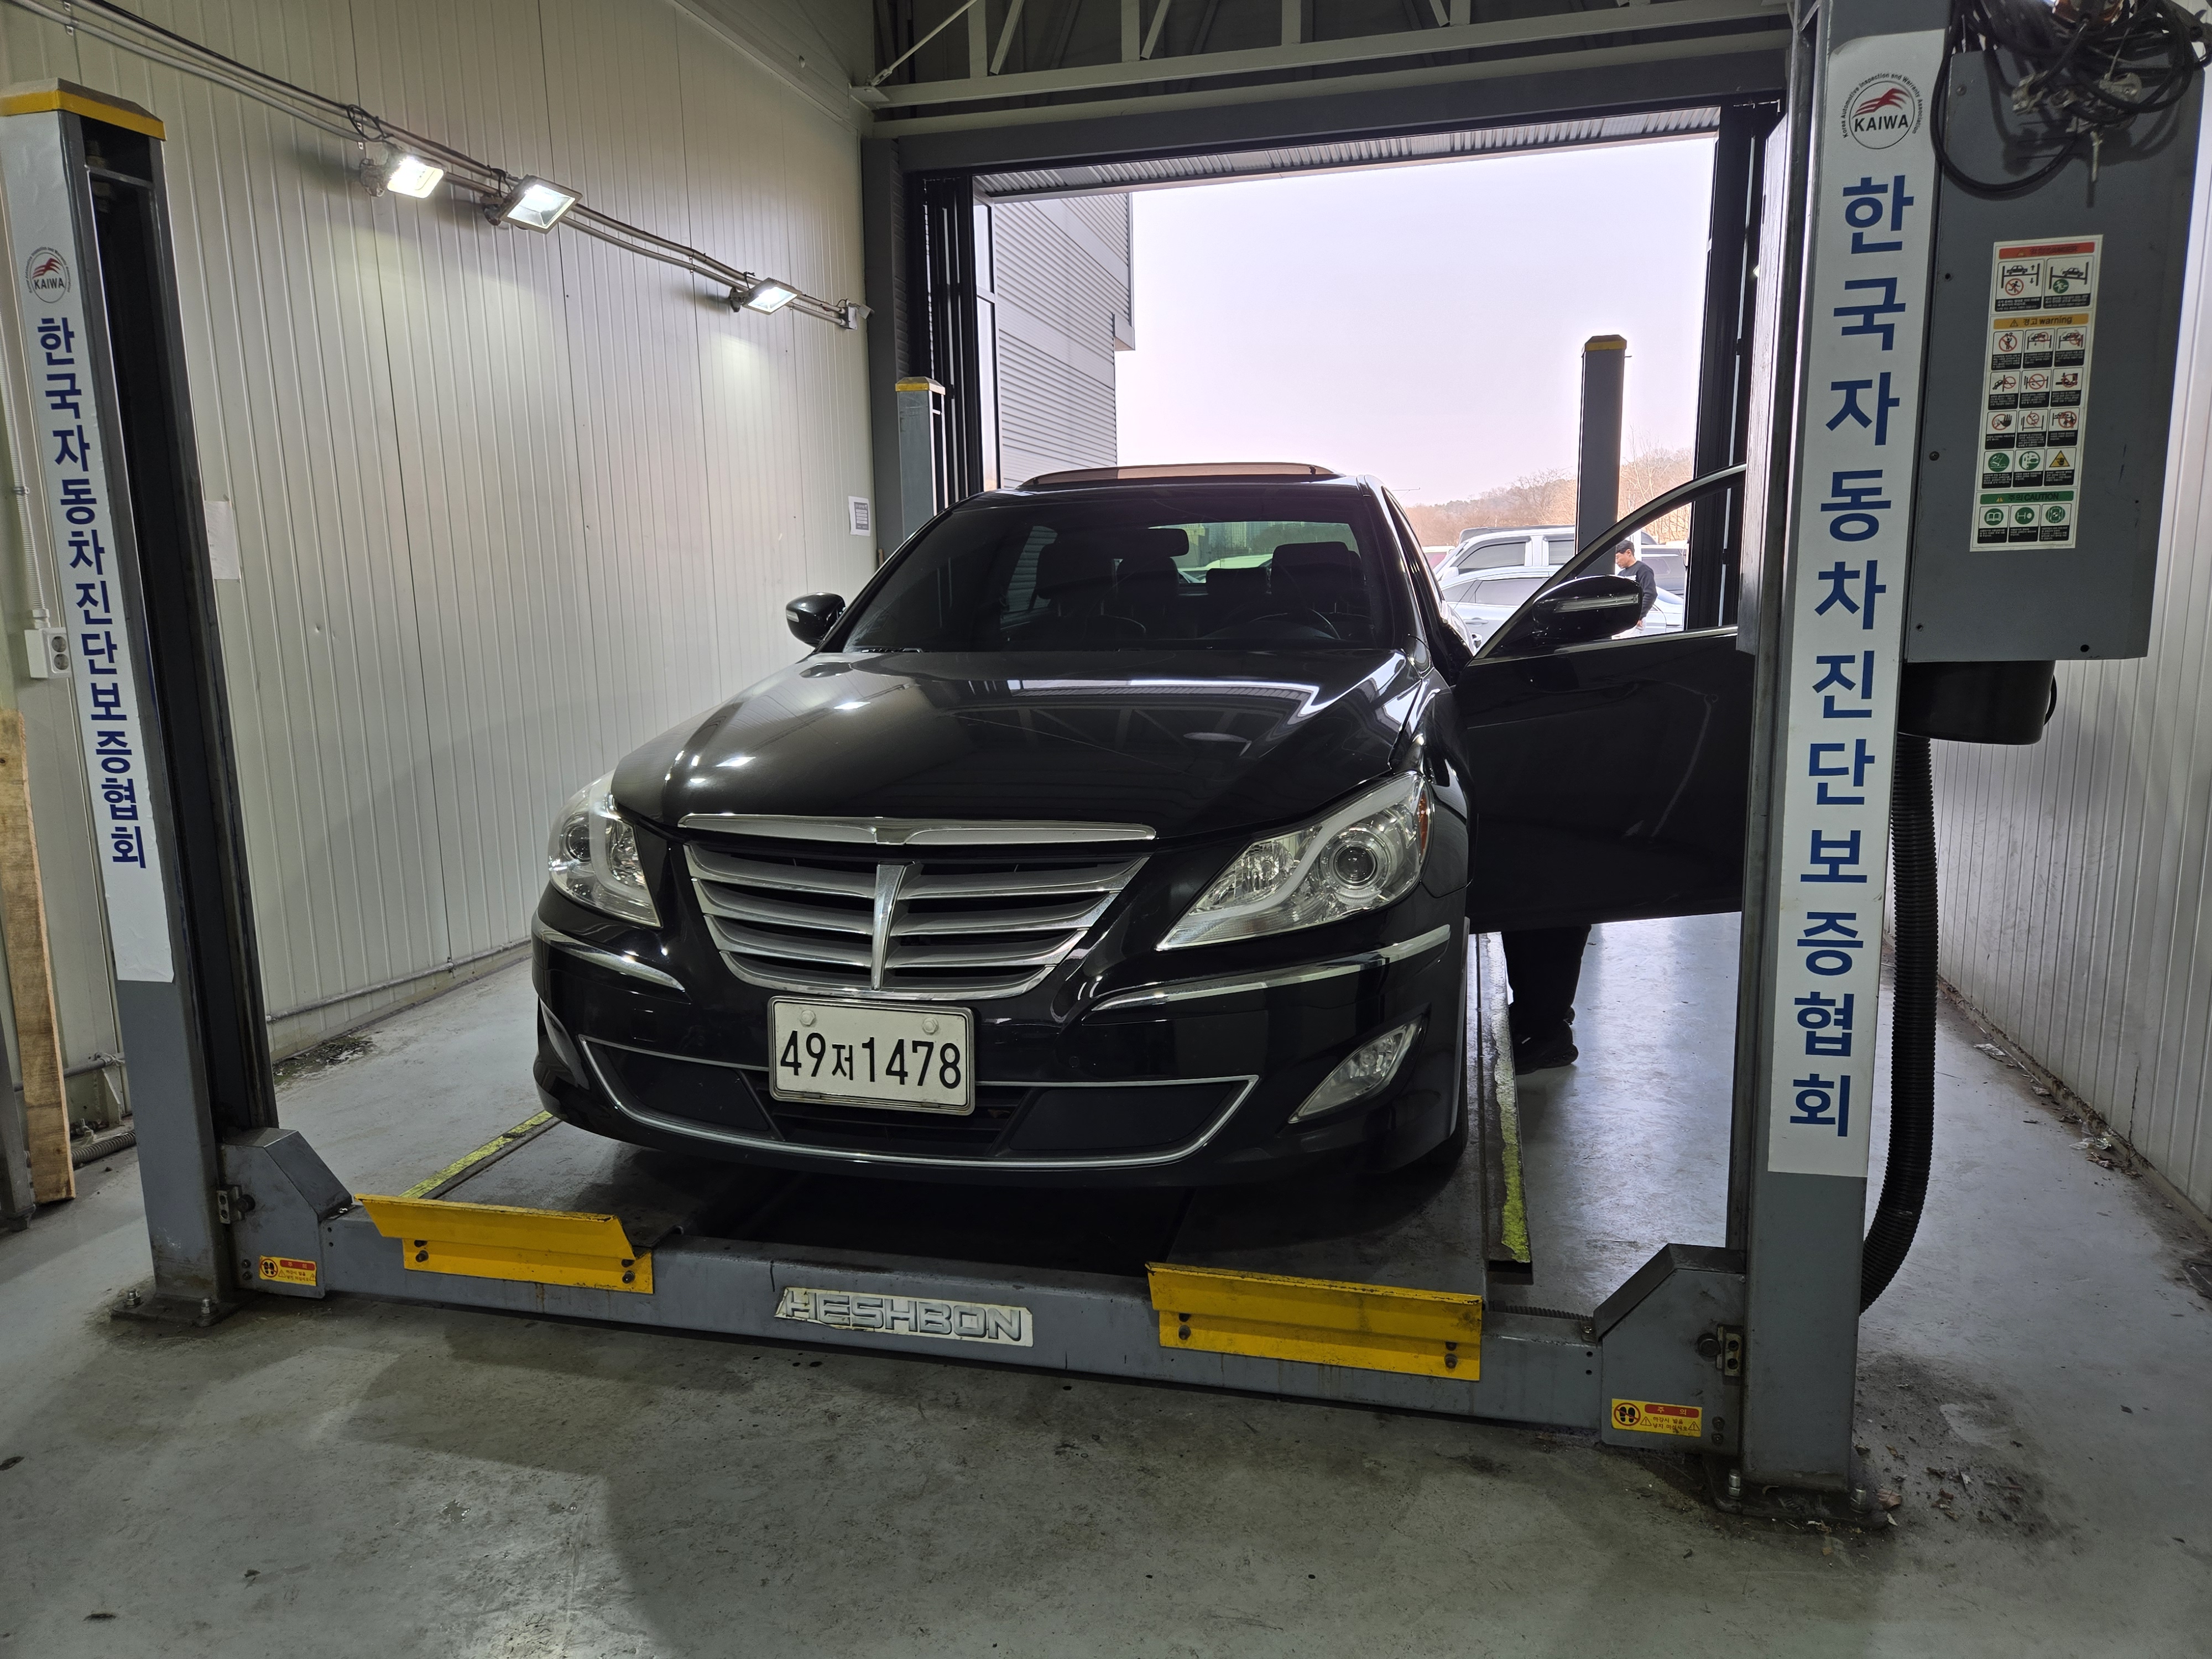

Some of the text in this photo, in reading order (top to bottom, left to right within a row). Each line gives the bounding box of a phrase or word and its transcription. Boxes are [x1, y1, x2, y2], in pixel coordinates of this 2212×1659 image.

[1840, 87, 1860, 119] Automotive
[1902, 76, 1921, 98] Warranty
[1854, 114, 1908, 132] KAIWA
[34, 278, 66, 290] KAIWA
[2039, 315, 2073, 325] warning
[2024, 492, 2059, 502] CAUTION
[37, 317, 147, 869] 한국자동차진단보증협회
[1790, 174, 1914, 1137] 한국자동차진단보증협회
[780, 1030, 961, 1089] 49저1478
[786, 1290, 1021, 1342] HESHBON
